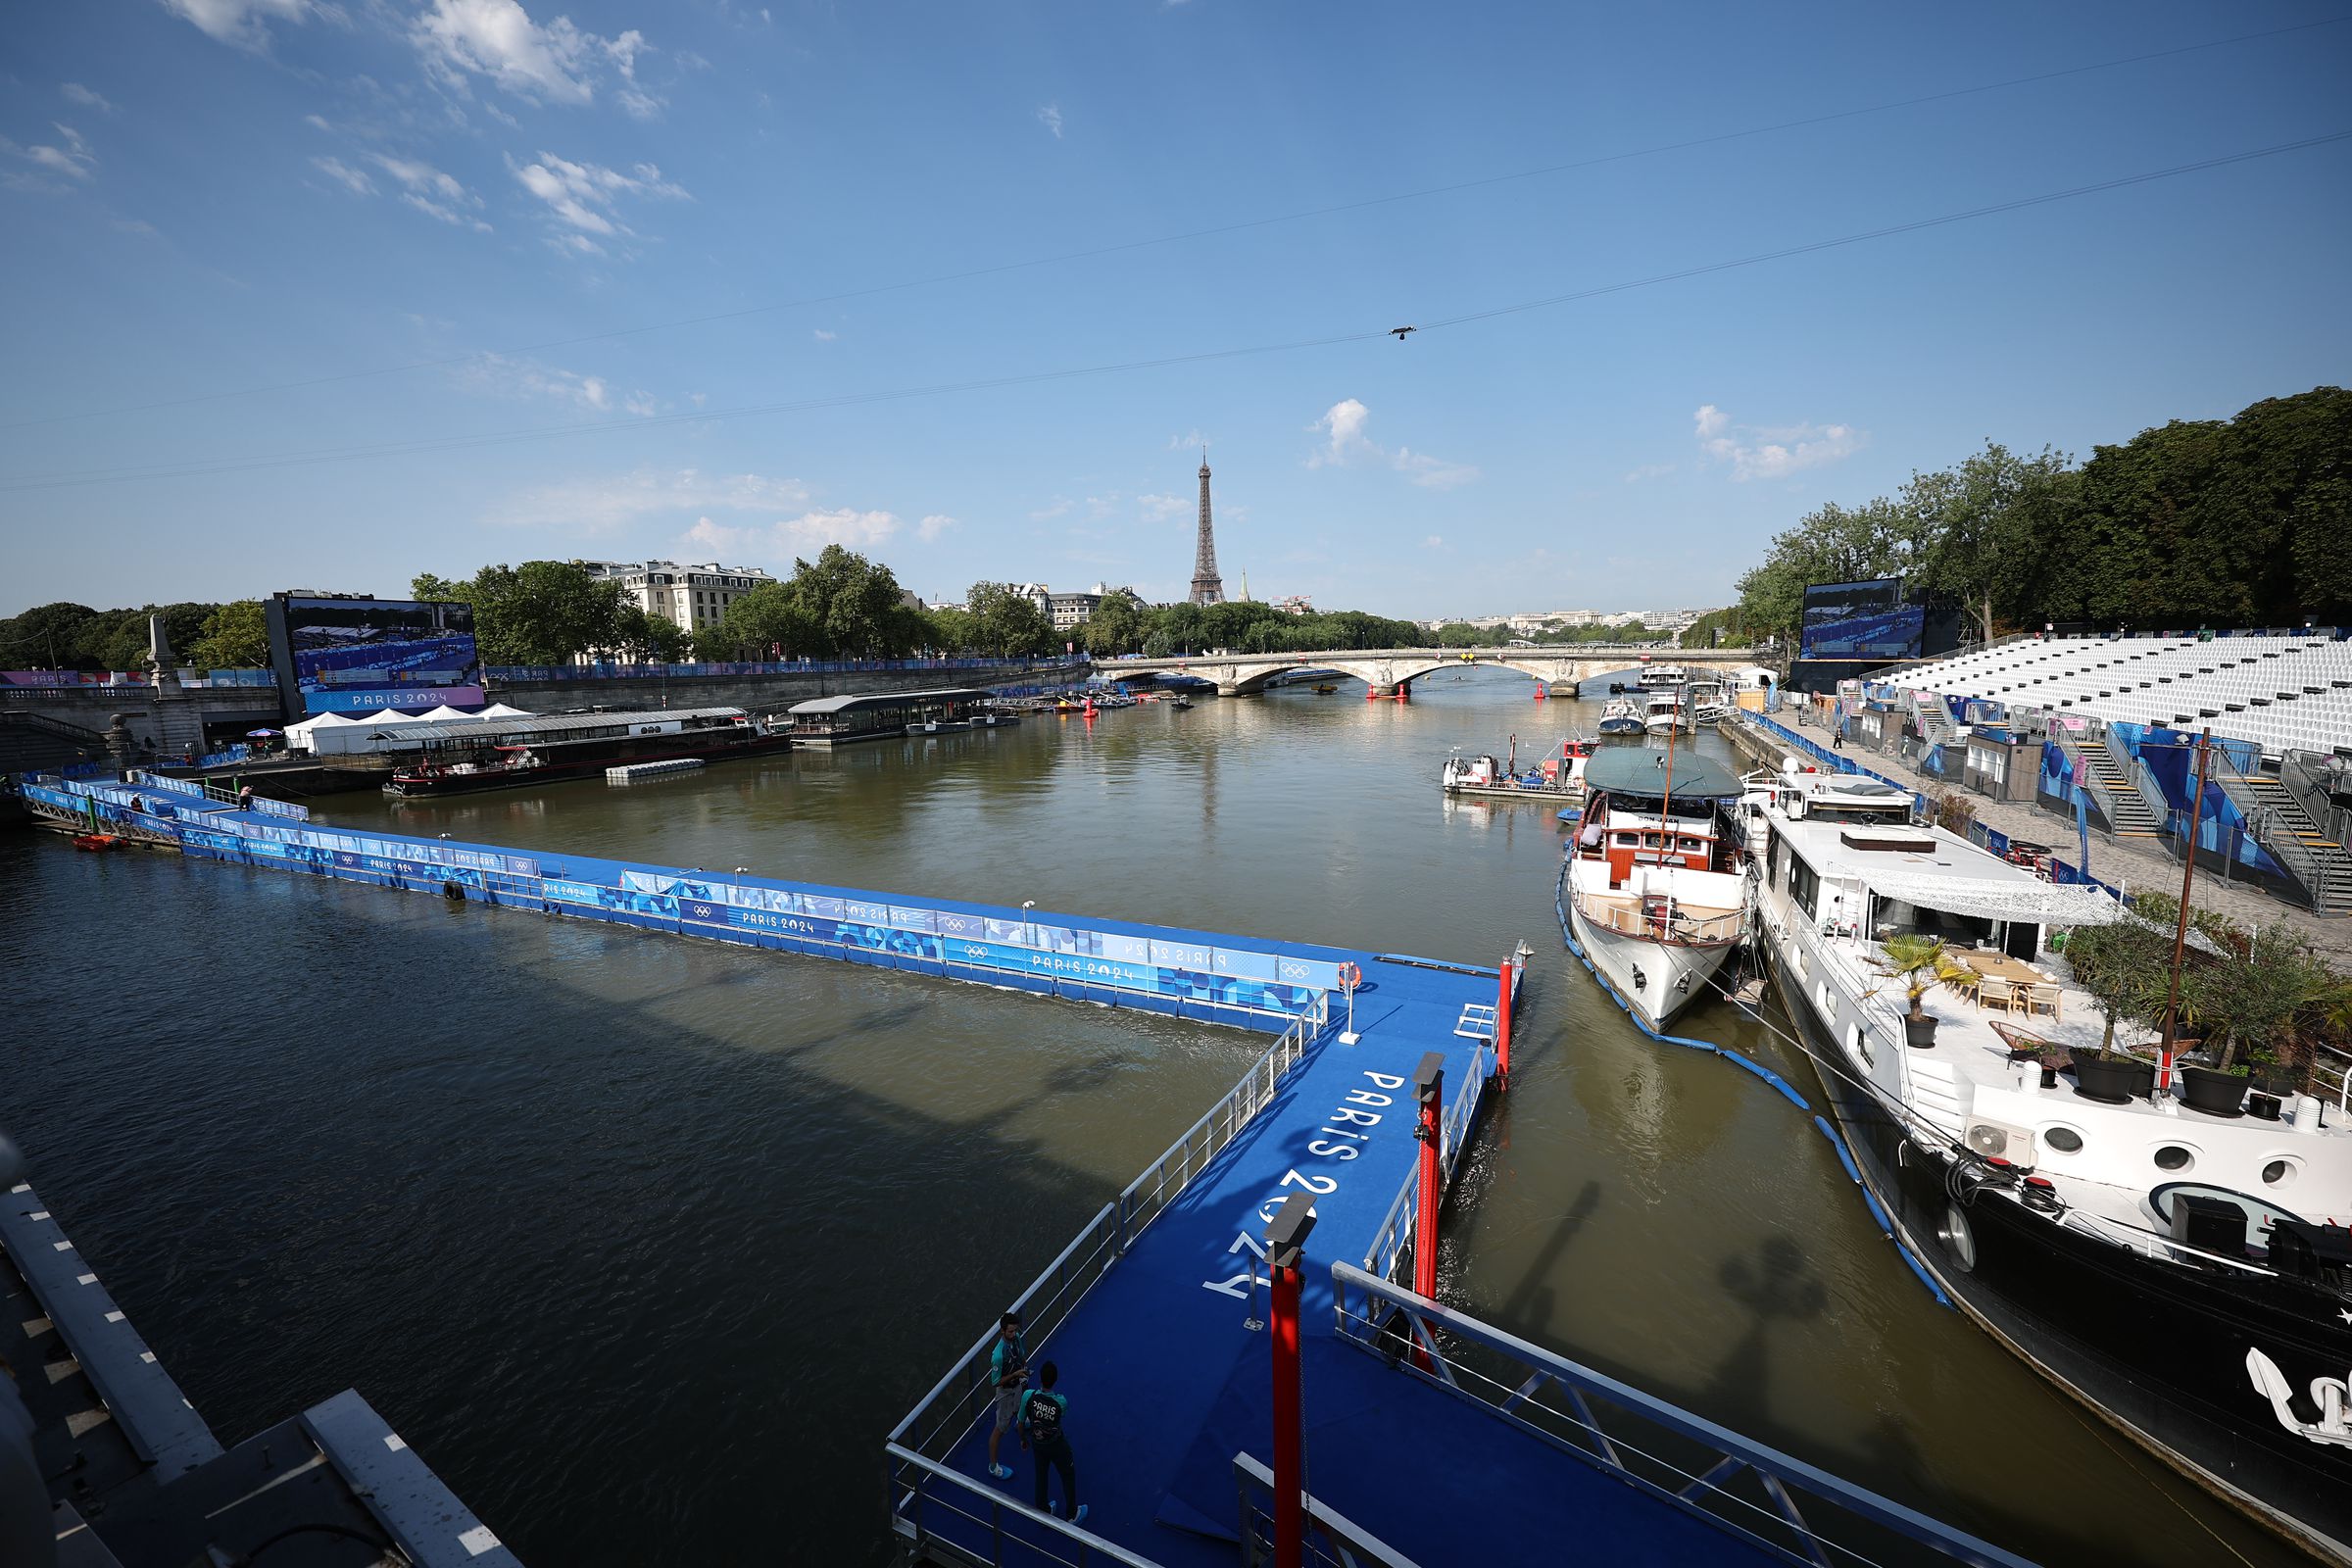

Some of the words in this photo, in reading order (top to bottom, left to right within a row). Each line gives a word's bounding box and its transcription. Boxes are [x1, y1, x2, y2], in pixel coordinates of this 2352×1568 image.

[408, 692, 447, 704] 2024
[781, 918, 814, 933] 2024
[1087, 962, 1134, 981] 2024
[1034, 1409, 1054, 1421] 024
